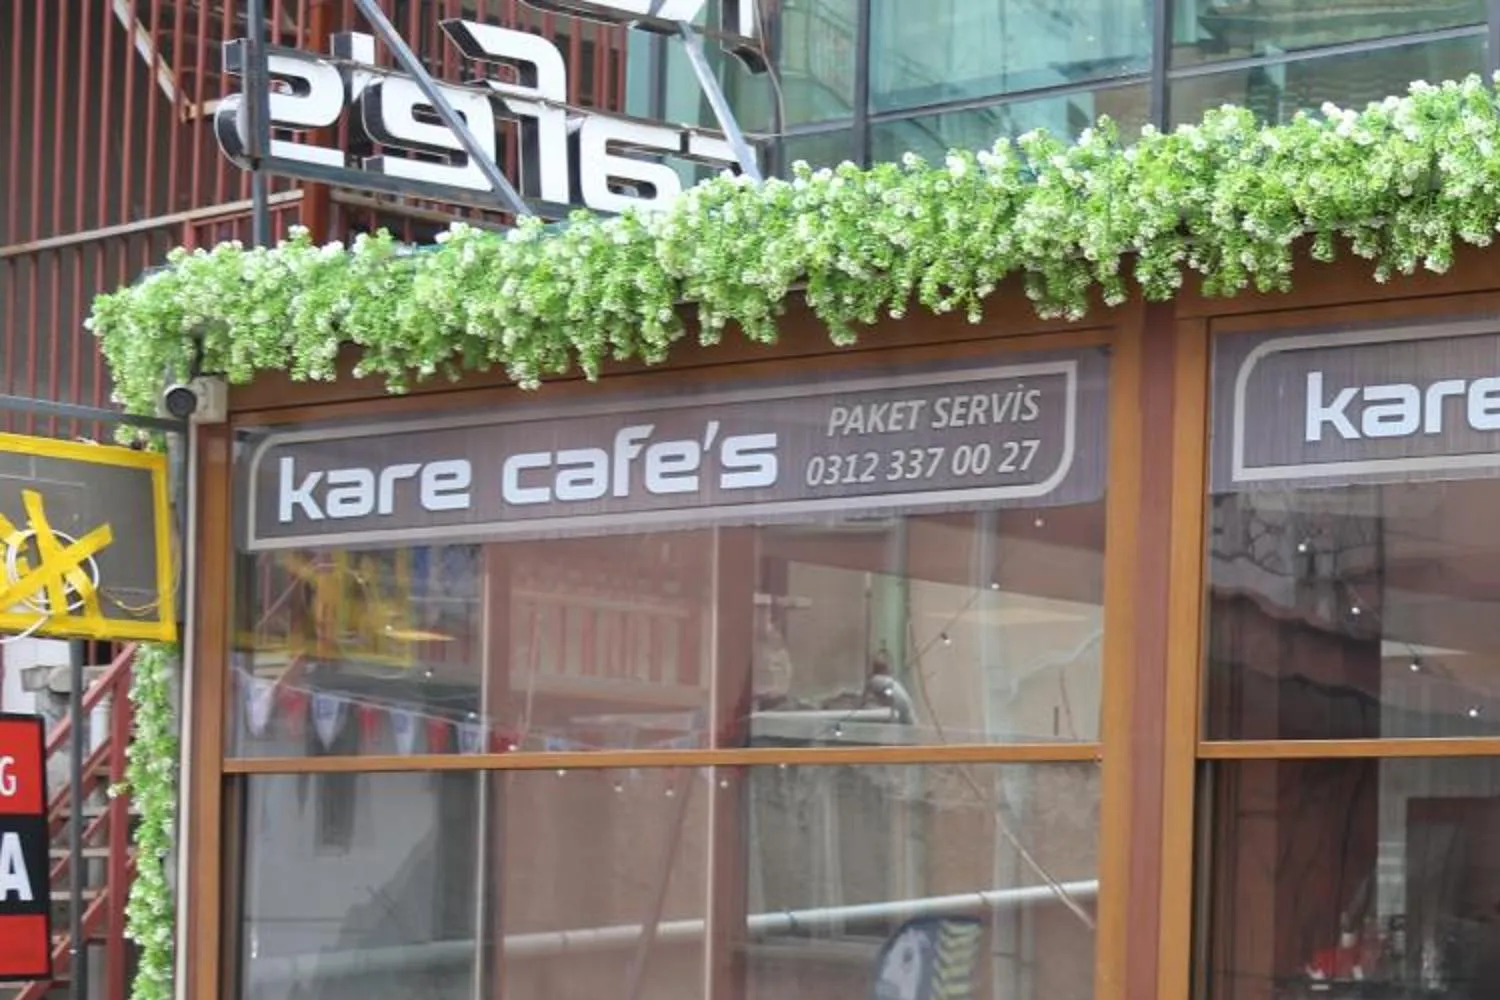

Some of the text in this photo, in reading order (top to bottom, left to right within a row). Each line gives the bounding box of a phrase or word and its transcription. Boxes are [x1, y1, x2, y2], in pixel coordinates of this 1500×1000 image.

[827, 383, 1041, 438] PAKET SERVİS
[278, 421, 779, 523] kare cafe's
[806, 438, 1041, 487] 0312 337 00 27
